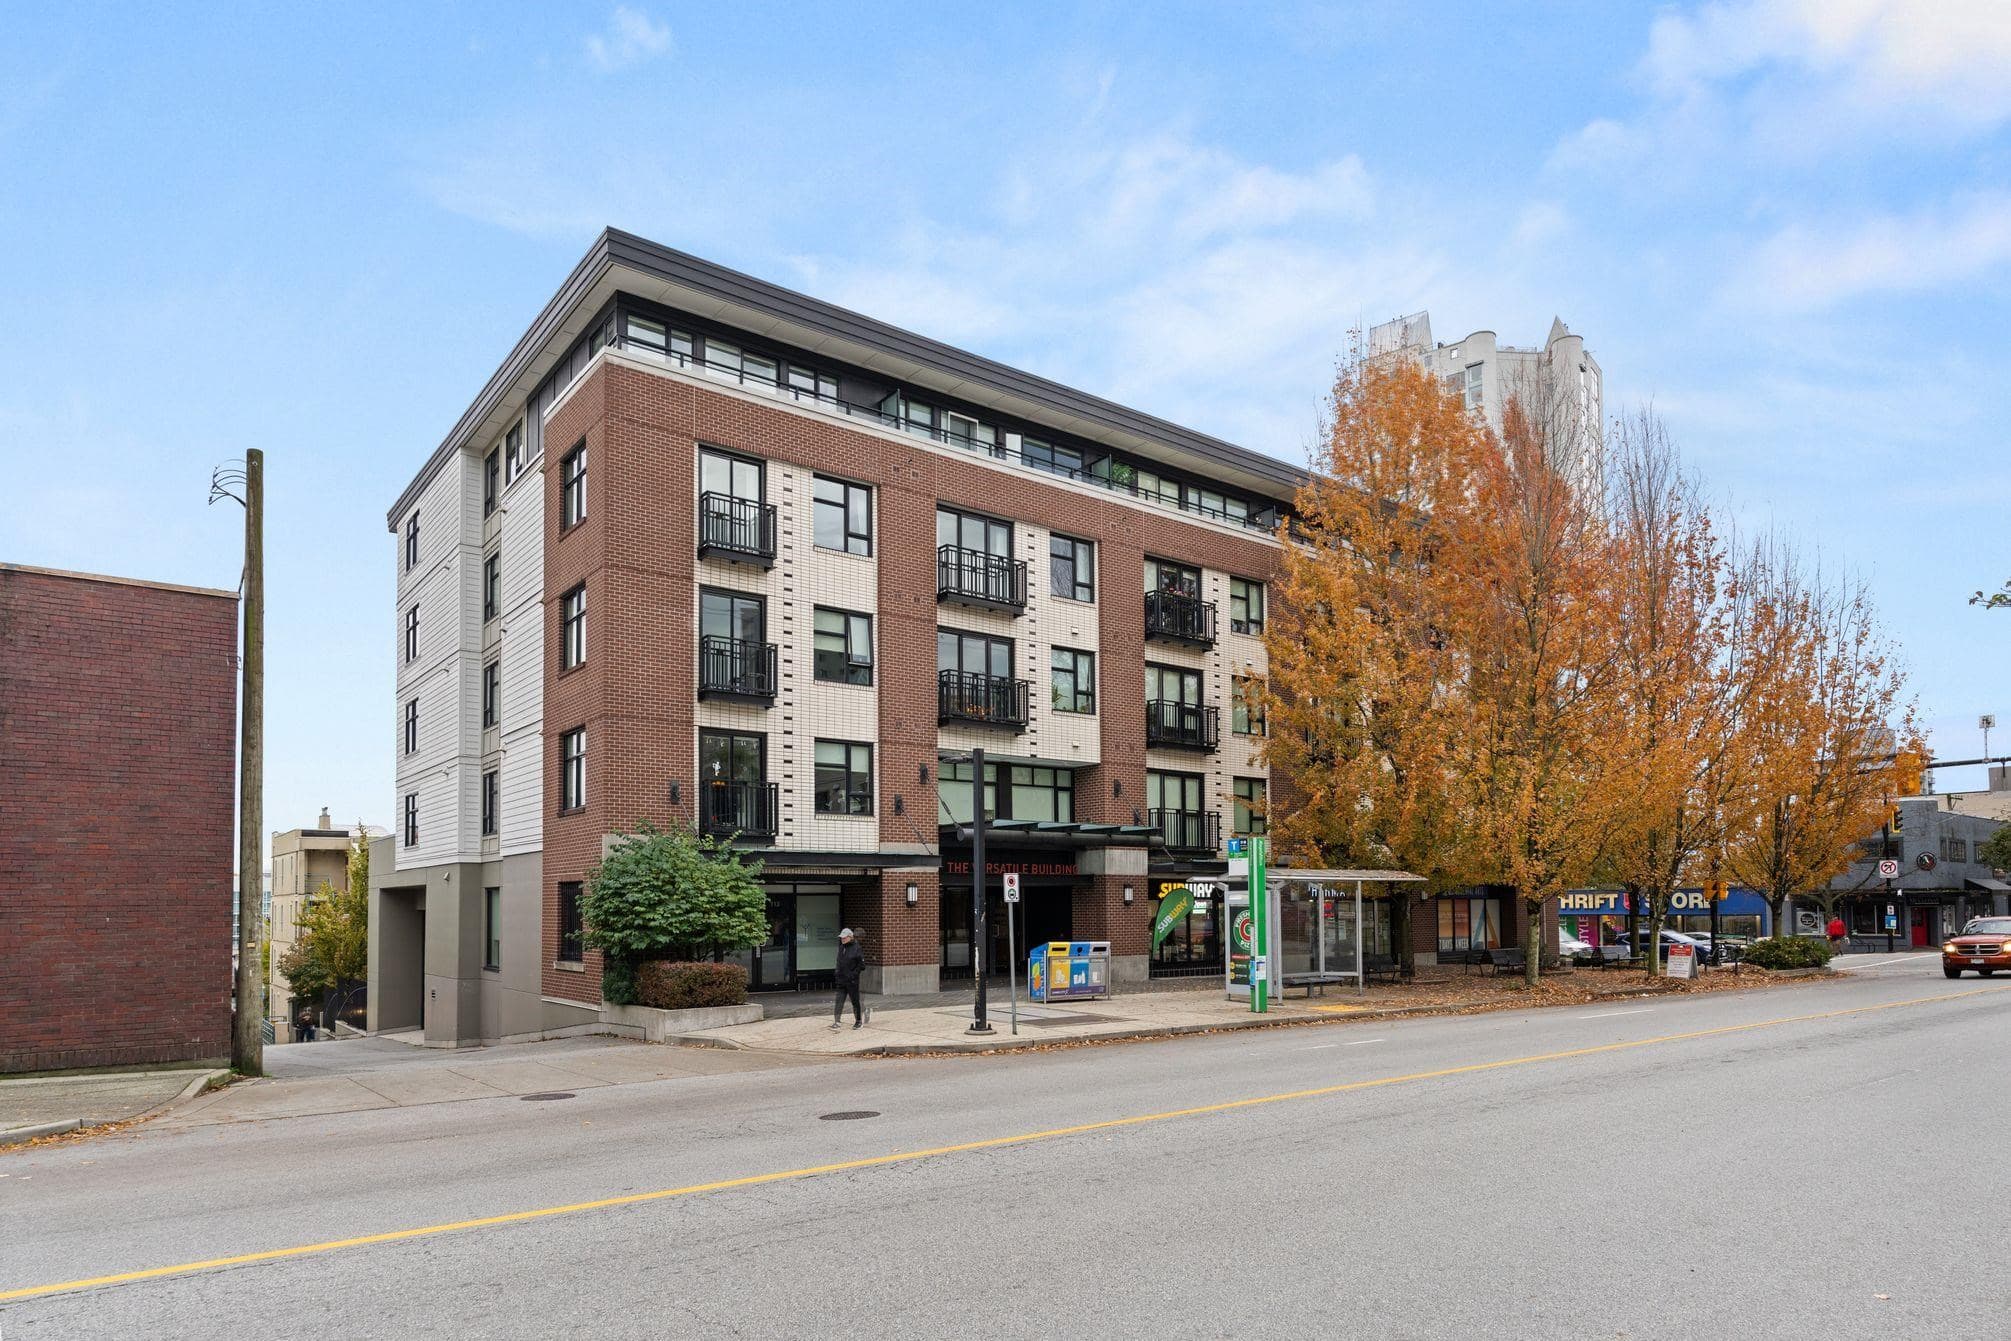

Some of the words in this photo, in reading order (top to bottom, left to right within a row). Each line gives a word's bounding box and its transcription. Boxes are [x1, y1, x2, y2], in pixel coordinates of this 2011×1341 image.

[947, 862, 969, 874] THE
[972, 863, 1029, 874] RSATILE
[1031, 864, 1080, 875] BUILDING
[1558, 893, 1619, 909] HRIFT
[1644, 892, 1711, 909] SOR
[1157, 896, 1188, 933] SUBWAY
[1578, 916, 1589, 945] STYLE
